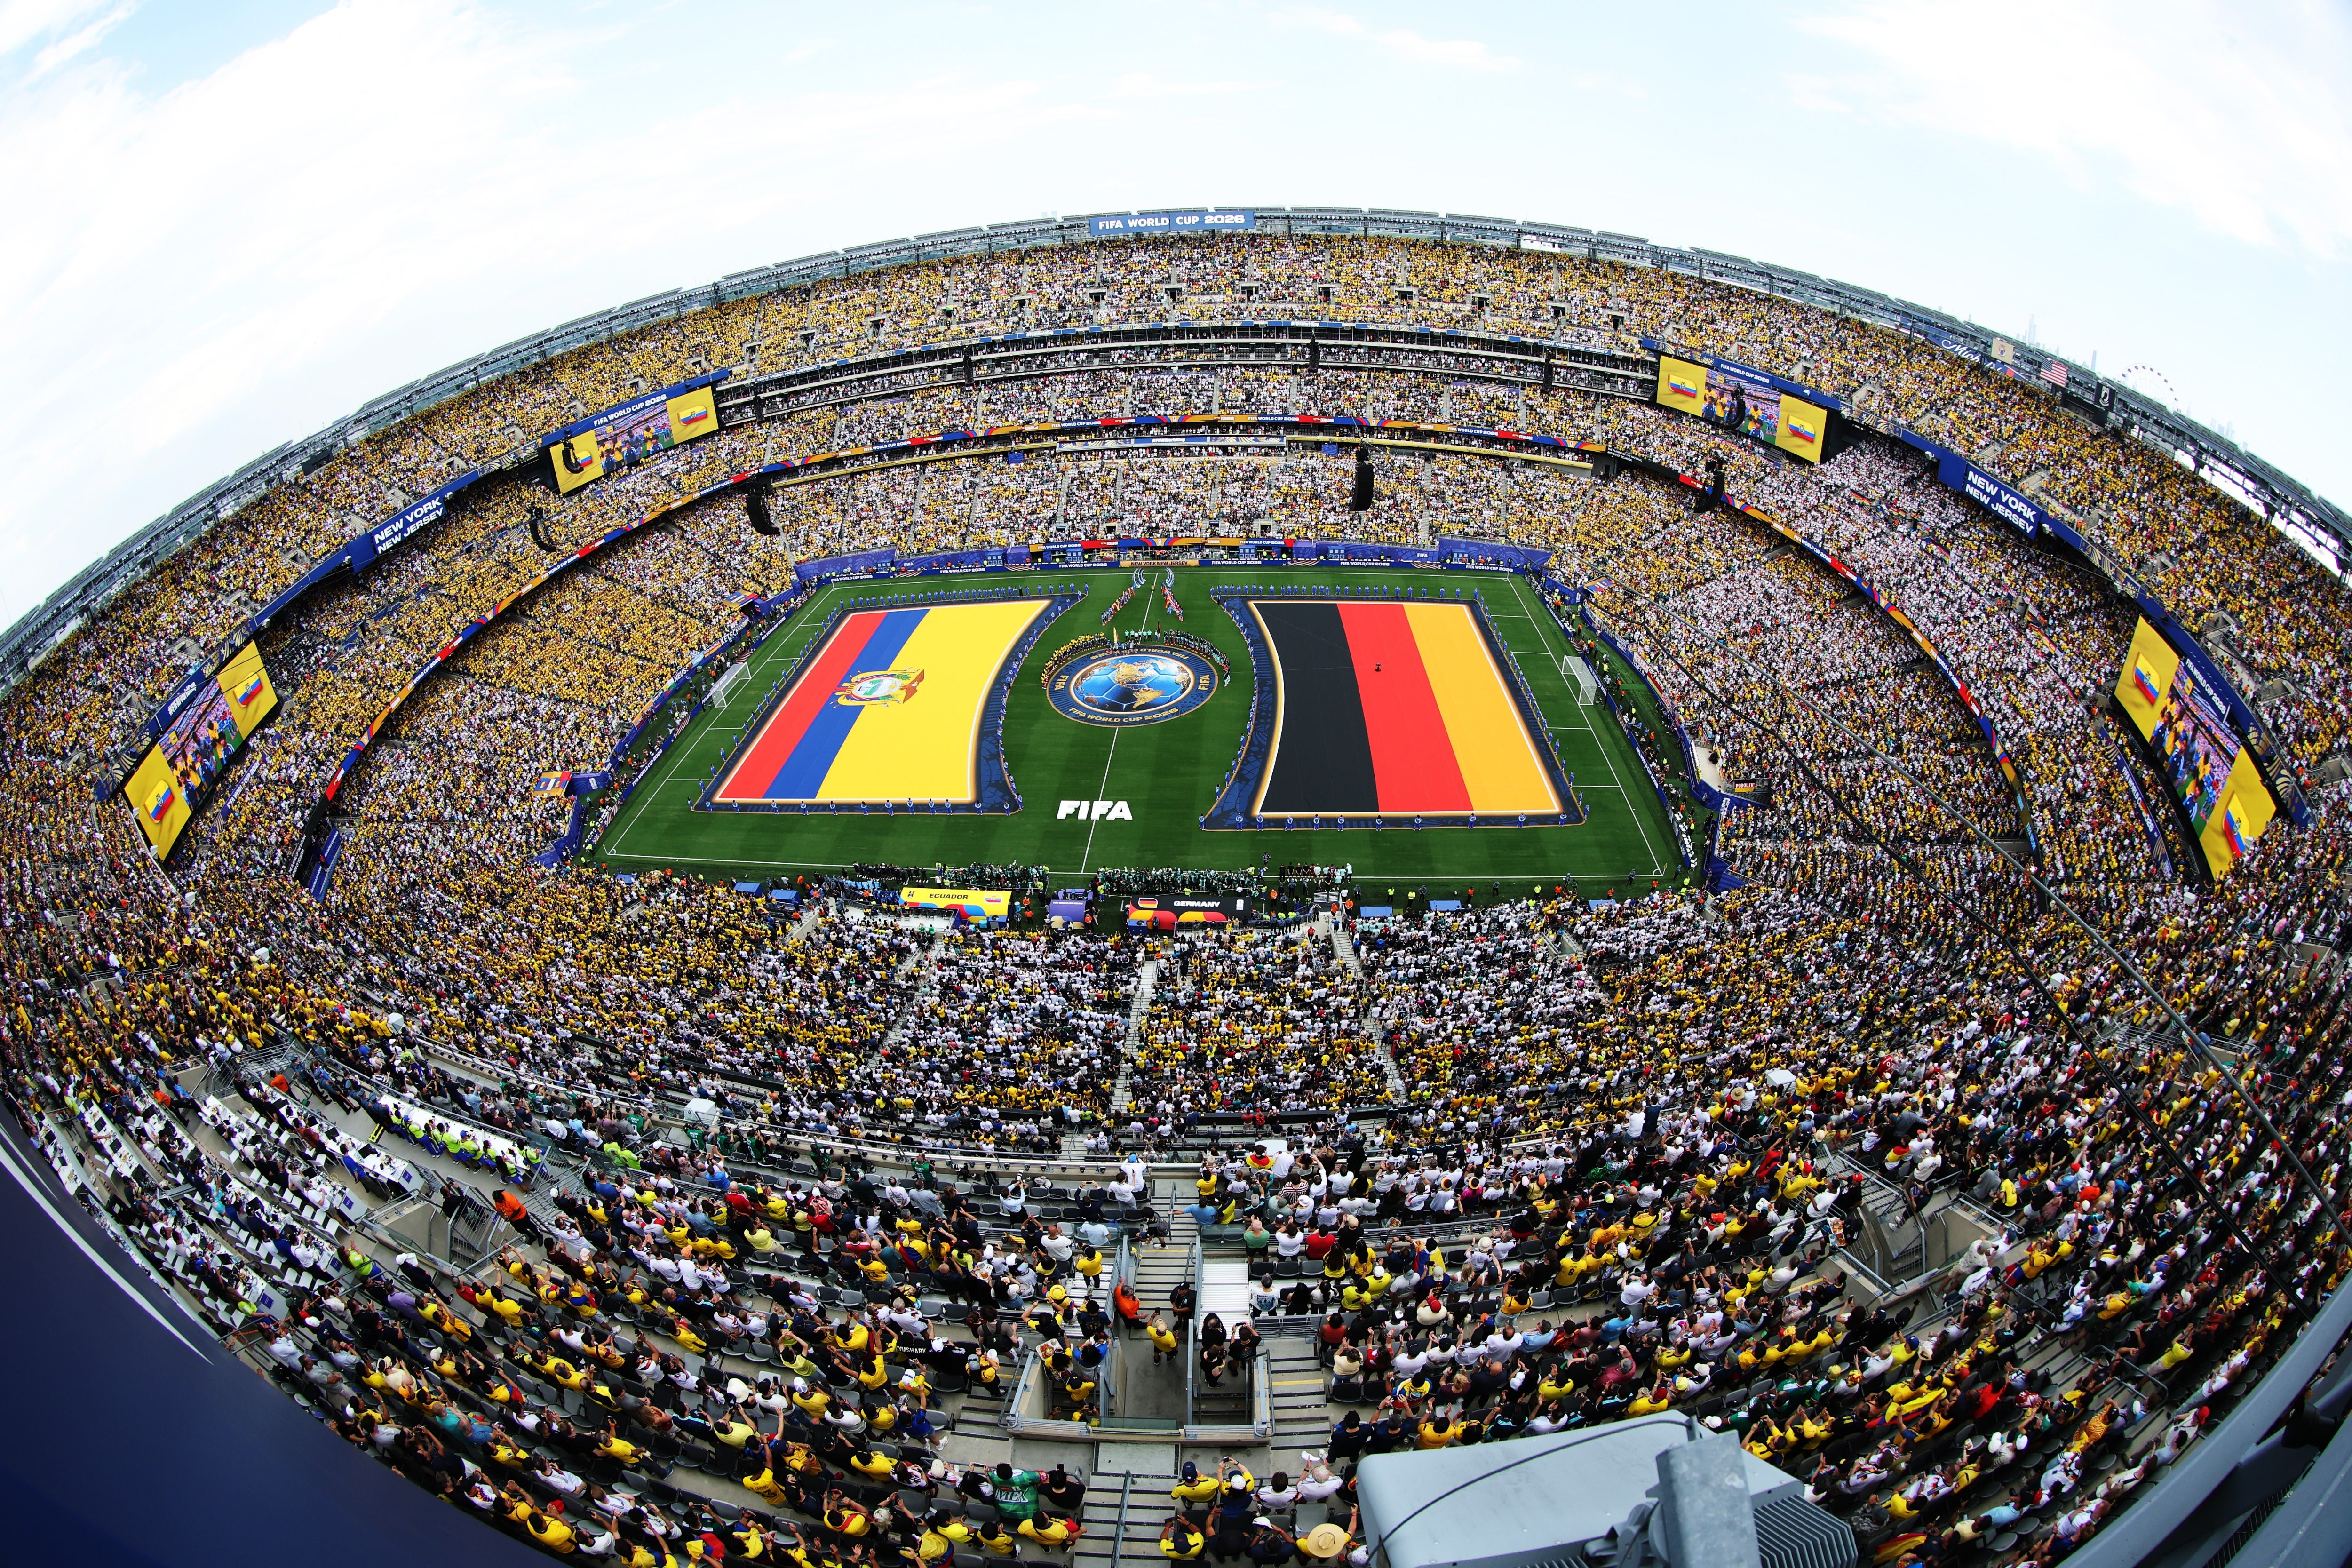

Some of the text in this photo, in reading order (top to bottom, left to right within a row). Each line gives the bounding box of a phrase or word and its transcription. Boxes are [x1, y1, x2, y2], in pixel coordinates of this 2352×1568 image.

[1099, 215, 1245, 230] FIFA WORLD CUP 2026
[1731, 366, 1745, 375] WORLD
[1754, 374, 1769, 383] 2026
[594, 394, 667, 427] FIFA WORLD CUP 2026
[1968, 471, 2036, 520] NEW YORK
[374, 497, 441, 542] NEW YORK
[1966, 484, 2034, 533] NEW JERSEY
[377, 508, 443, 554] NEW JERSEY
[1054, 674, 1070, 691] FIFA
[1198, 674, 1210, 691] FIFA
[2186, 659, 2228, 714] FIFA WORLD CUP 2026
[1068, 707, 1086, 718] FIFA
[1087, 714, 1120, 723] WORLD
[1144, 708, 1179, 721] 2026
[638, 766, 648, 779] WORLD
[653, 749, 663, 762] 2026
[234, 782, 245, 798] WORL
[1057, 800, 1133, 820] FIFA
